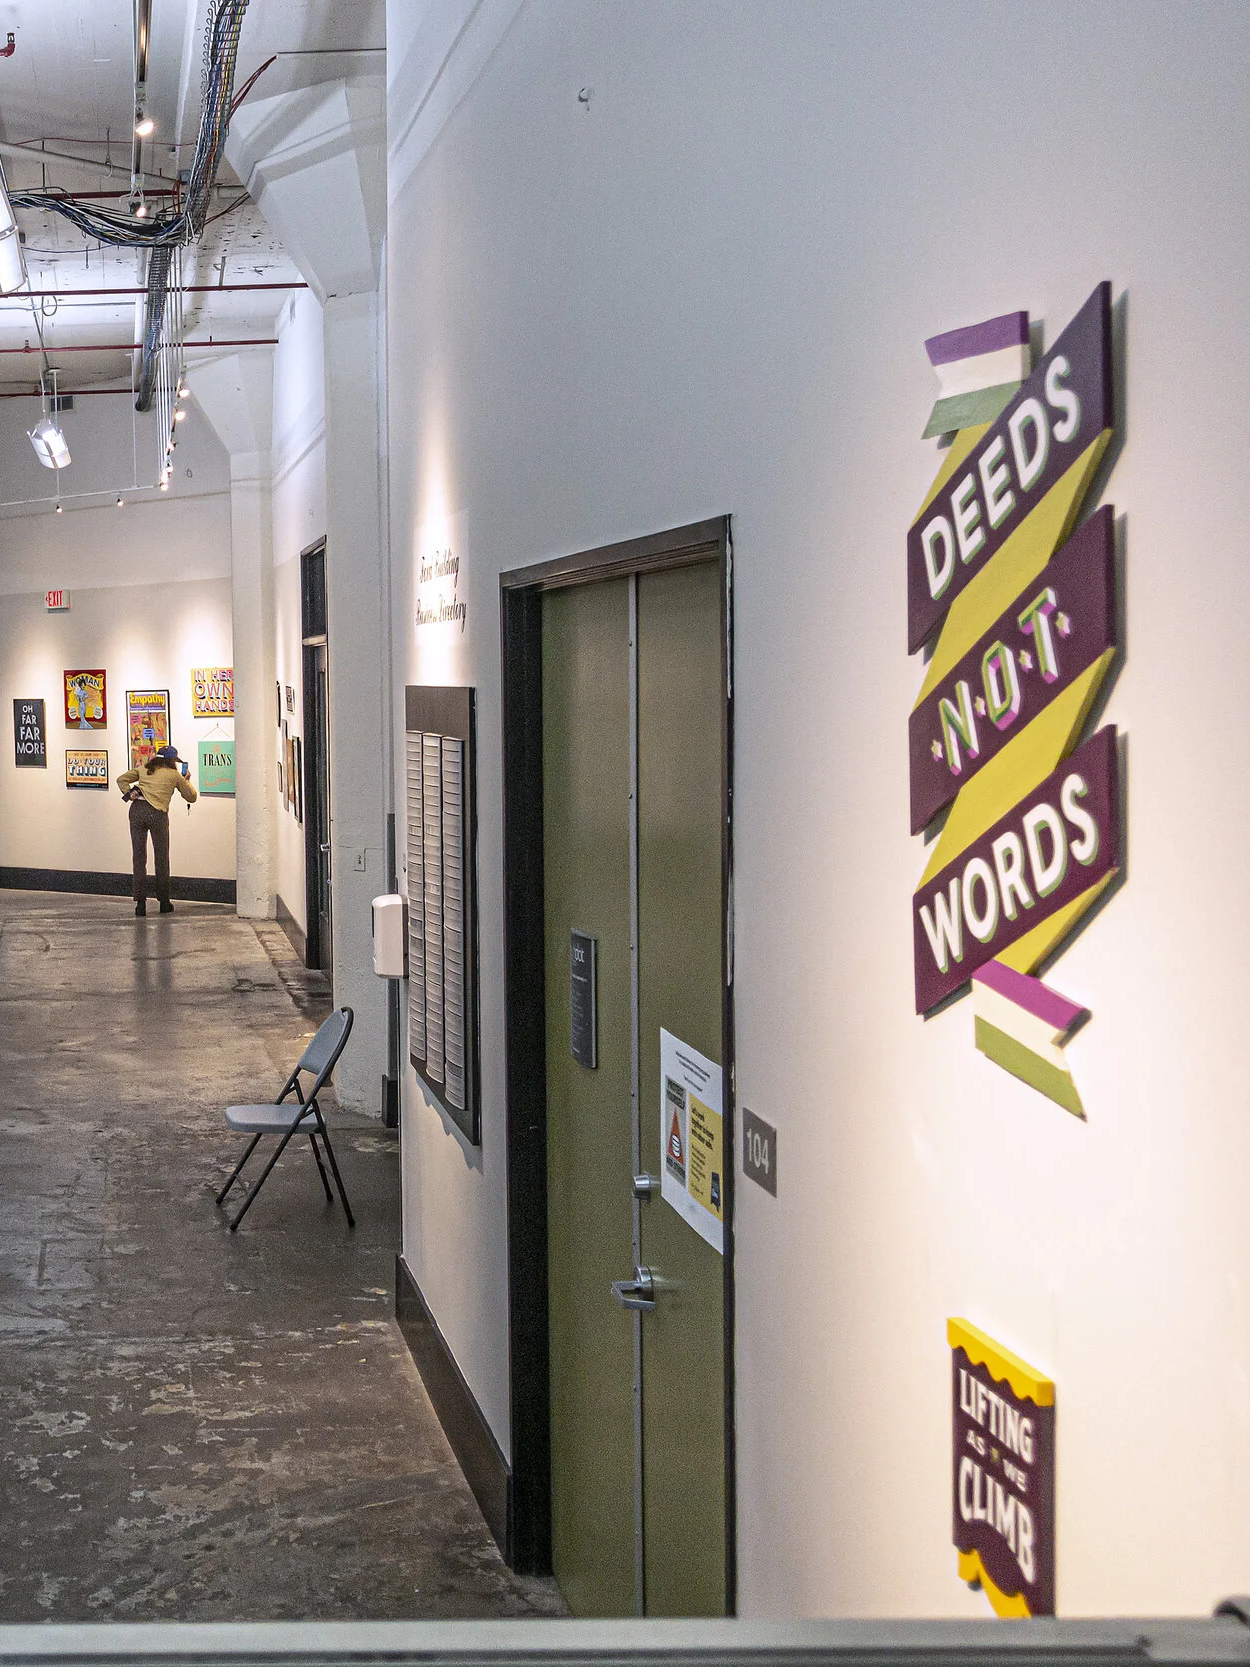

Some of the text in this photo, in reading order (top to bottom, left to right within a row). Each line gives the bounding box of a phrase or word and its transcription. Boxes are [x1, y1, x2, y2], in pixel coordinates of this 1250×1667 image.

[920, 354, 1082, 600] DEEDS
[48, 590, 62, 606] EXIT
[69, 675, 100, 688] WOMAN
[194, 669, 234, 682] IN HER
[195, 683, 234, 699] OWN
[130, 692, 166, 706] Empathy
[195, 700, 234, 712] HANDS
[22, 705, 33, 713] OH
[21, 714, 37, 725] FAR
[20, 726, 41, 741] FAR
[16, 742, 45, 755] MORE
[84, 758, 106, 766] YOUR
[203, 753, 232, 767] TRANS
[68, 766, 106, 777] THING
[920, 772, 1100, 974] WORDS
[746, 1128, 769, 1174] 104
[959, 1367, 1033, 1464] LIFTING
[966, 1429, 1028, 1492] AS WE
[958, 1455, 1036, 1585] CLIMB
